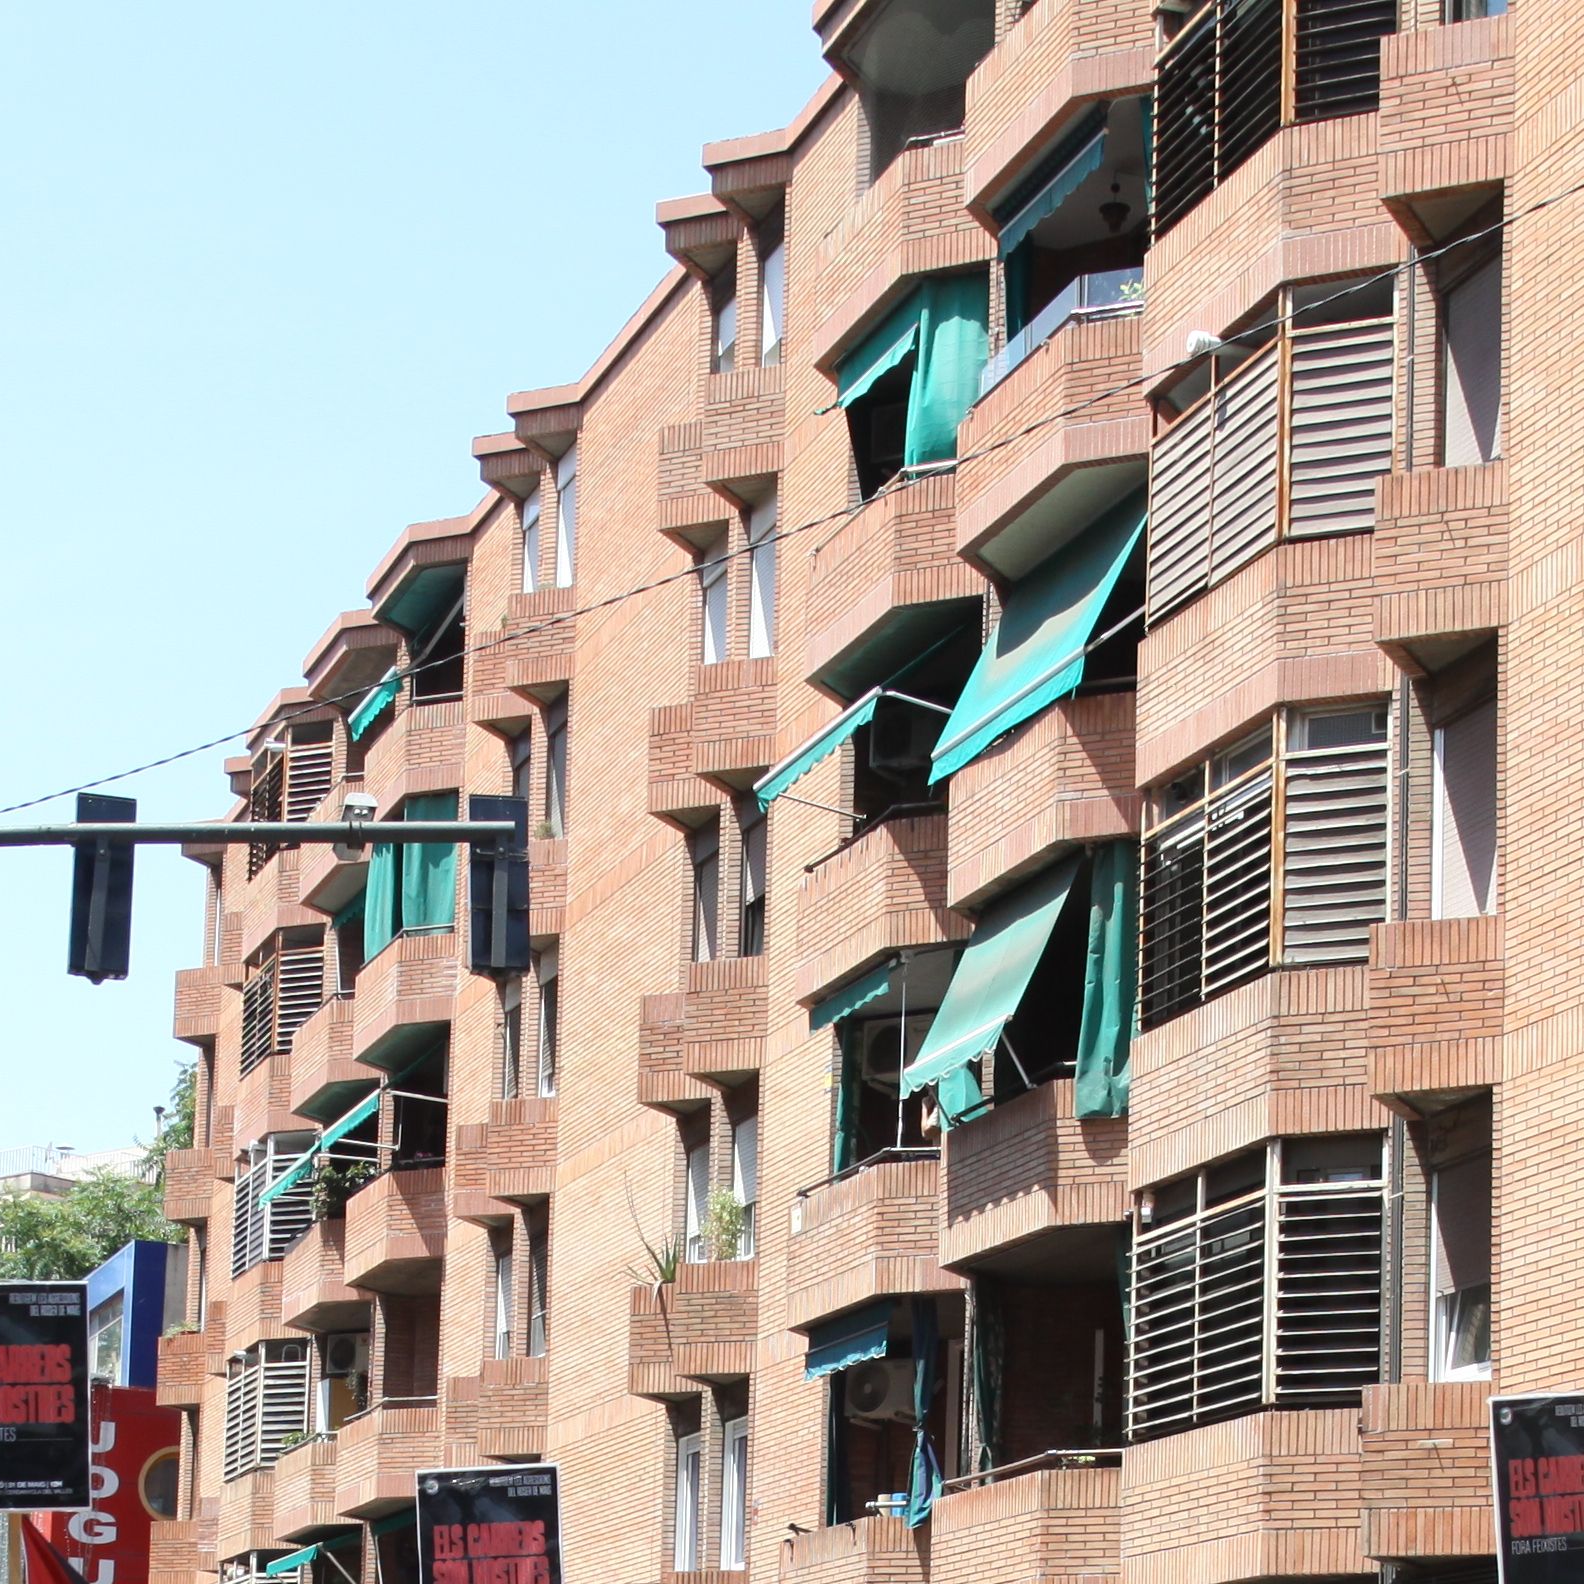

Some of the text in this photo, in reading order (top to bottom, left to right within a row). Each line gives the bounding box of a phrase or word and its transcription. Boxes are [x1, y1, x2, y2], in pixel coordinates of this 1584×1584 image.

[1508, 1458, 1536, 1498] ELS
[433, 1520, 545, 1559] ELS CARRERS
[1511, 1540, 1531, 1555] FORA
